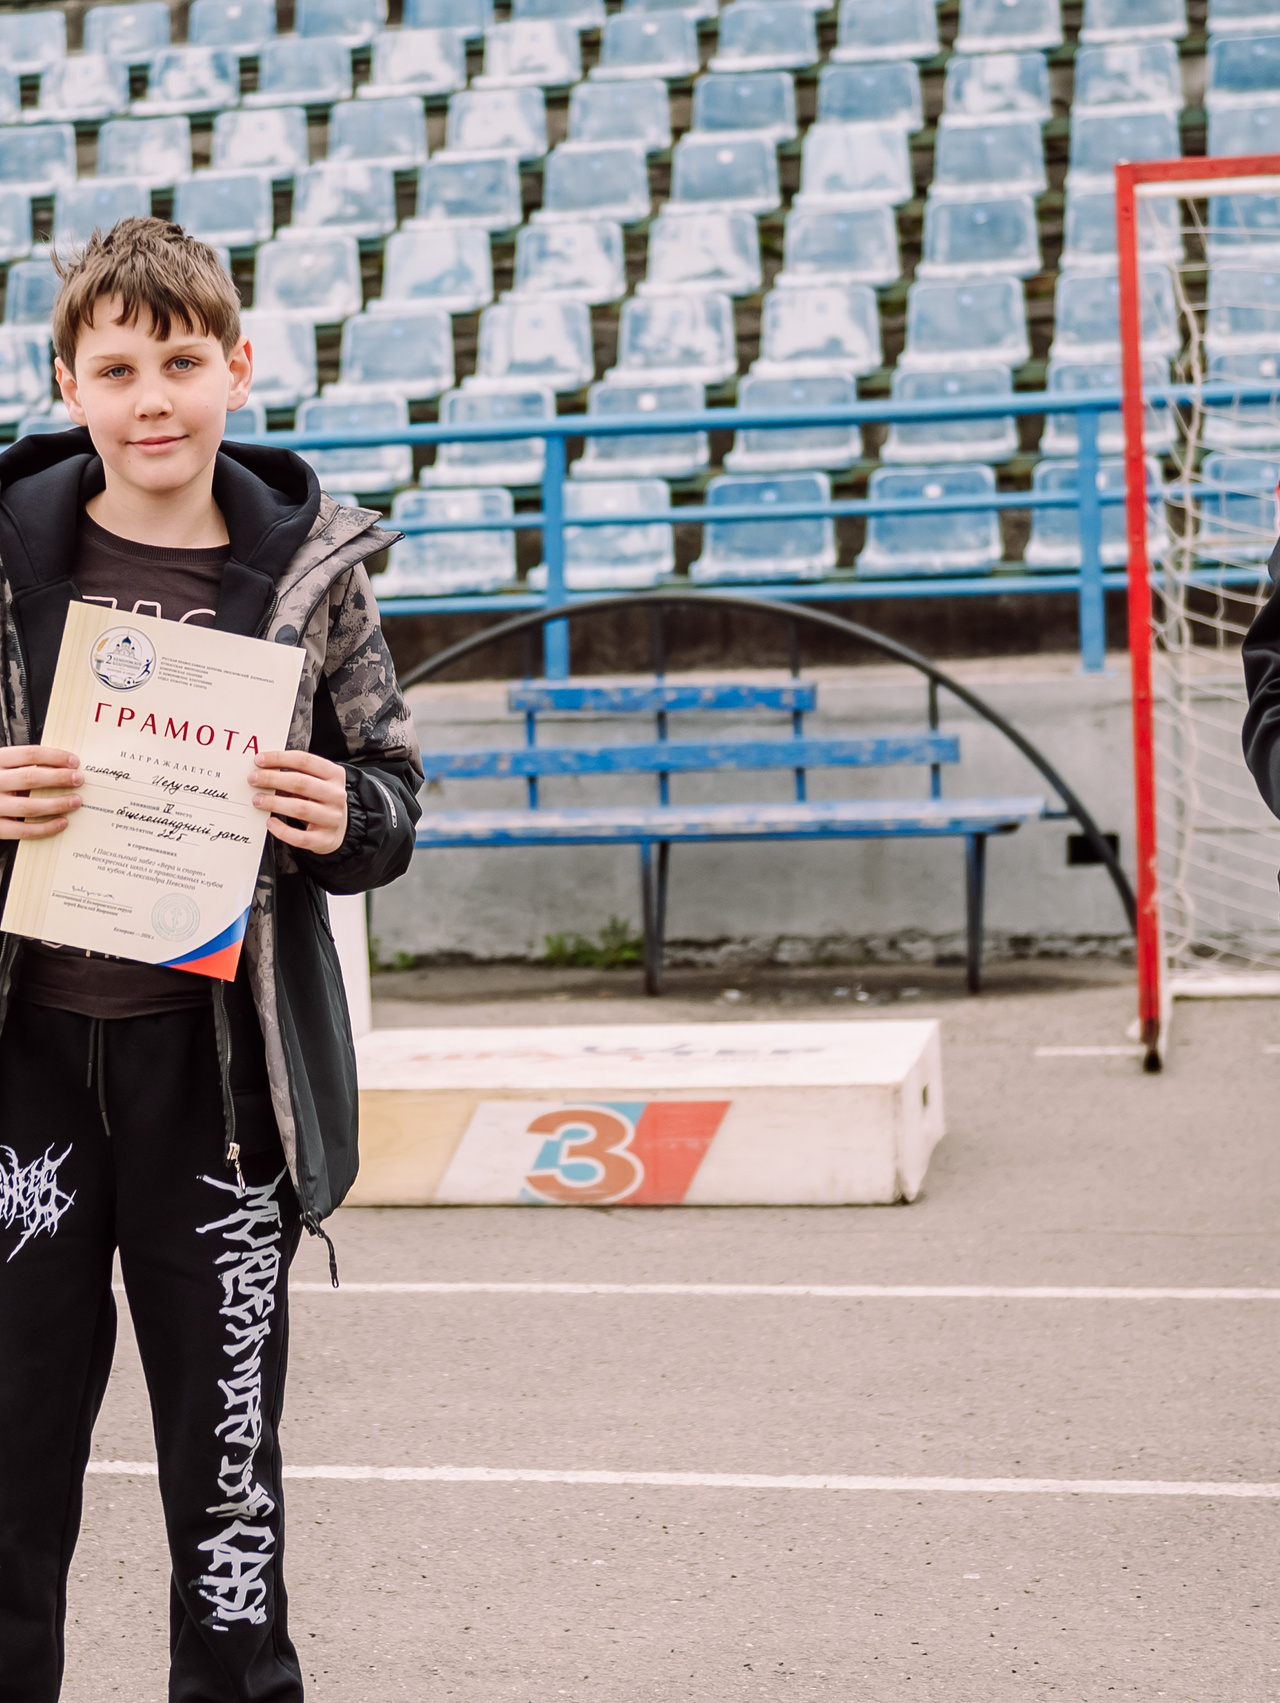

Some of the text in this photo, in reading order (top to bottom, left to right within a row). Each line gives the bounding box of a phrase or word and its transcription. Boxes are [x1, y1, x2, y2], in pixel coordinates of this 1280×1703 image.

[94, 702, 260, 756] ГРАМОТА
[120, 751, 222, 779] НАГРАЖДАЕТСЯ
[152, 775, 229, 800] Иерусалим
[130, 801, 160, 812] занявший
[175, 810, 193, 819] место
[116, 824, 154, 837] результатом
[97, 848, 138, 863] Пасхальный
[138, 856, 157, 867] забег
[132, 843, 177, 858] соревнованиях
[72, 852, 92, 861] среди
[91, 856, 129, 869] воскресных
[129, 863, 148, 873] школ
[154, 868, 200, 884] православных
[200, 878, 224, 889] клубов
[97, 864, 196, 891] на кубок Александра Невского
[524, 1104, 646, 1205] 3
